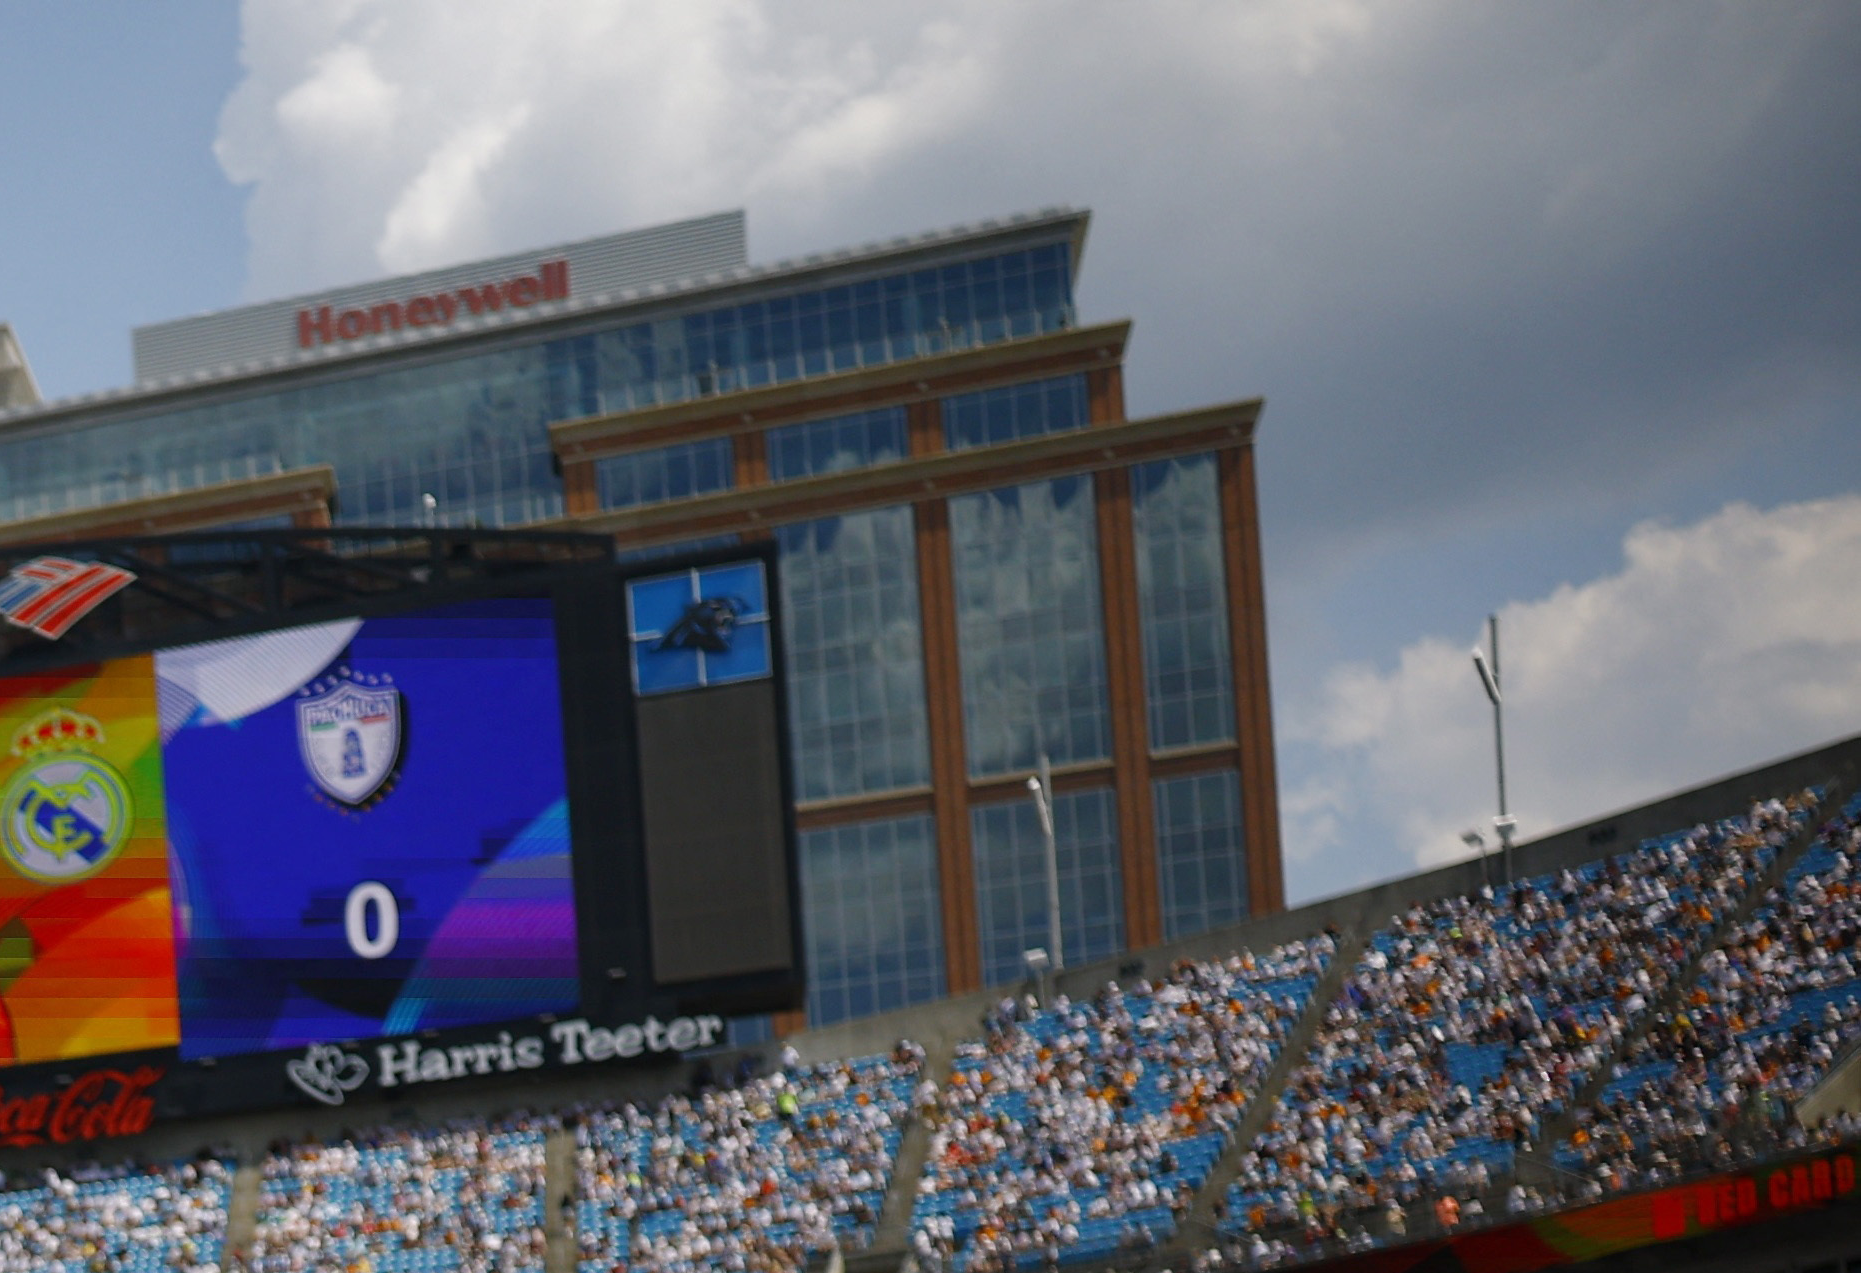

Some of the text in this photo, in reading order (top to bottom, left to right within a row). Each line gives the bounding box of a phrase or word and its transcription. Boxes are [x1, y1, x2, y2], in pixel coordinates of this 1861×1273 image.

[297, 259, 570, 349] Honeywell
[344, 880, 399, 959] 0
[377, 1014, 724, 1087] Harris Teeter
